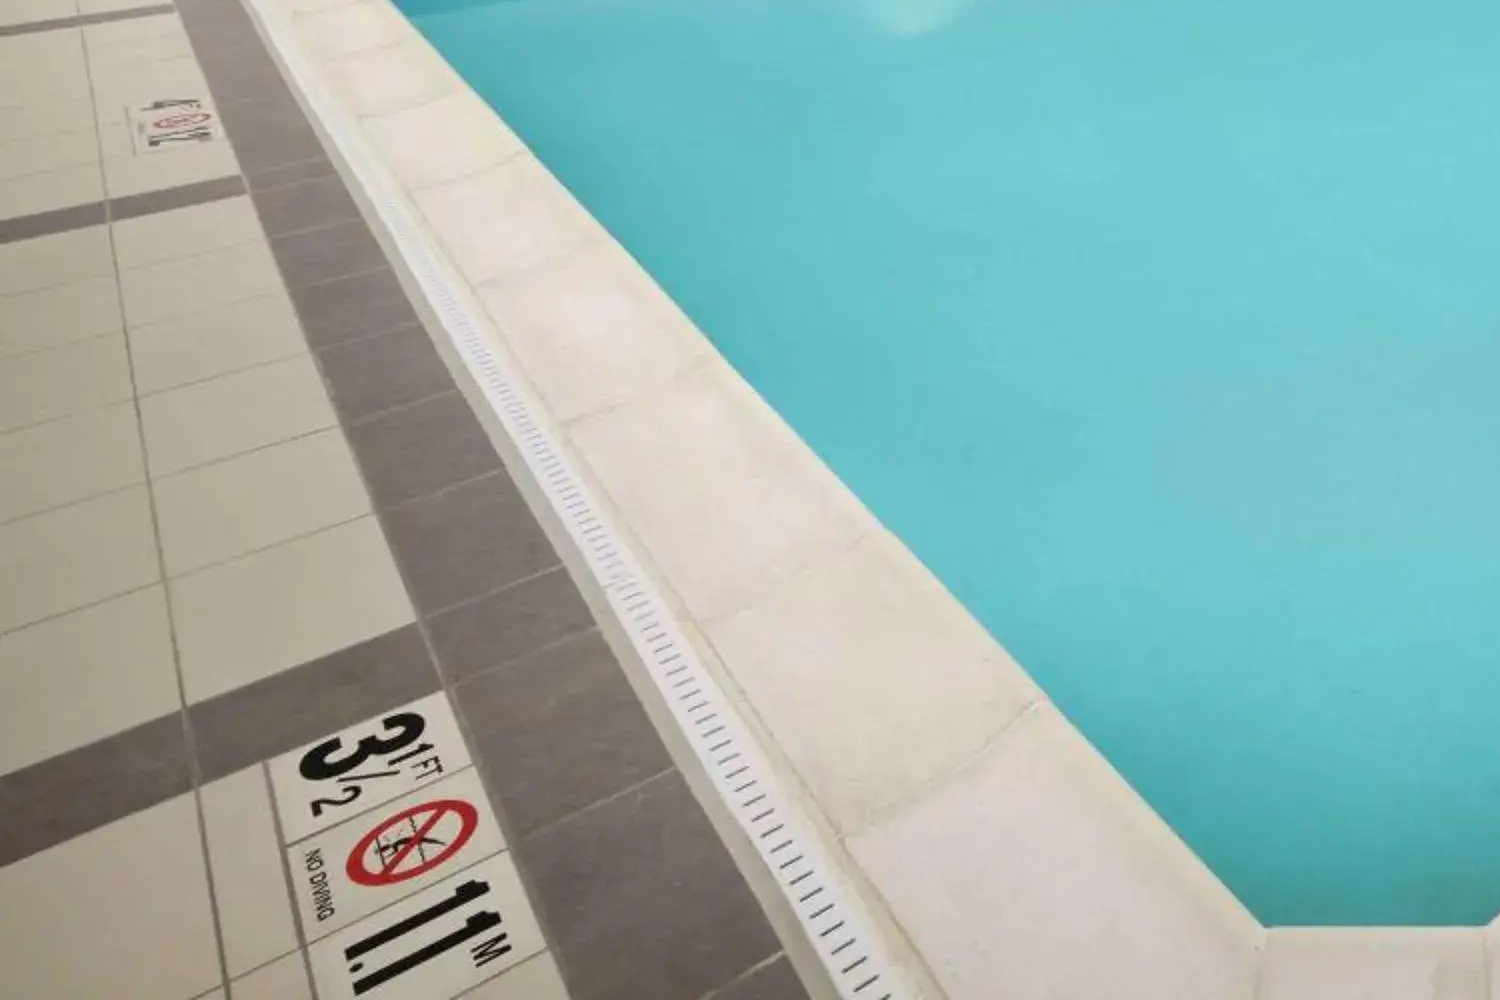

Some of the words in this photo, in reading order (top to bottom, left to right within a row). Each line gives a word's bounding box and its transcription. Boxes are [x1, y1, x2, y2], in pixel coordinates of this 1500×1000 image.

[411, 755, 444, 780] FT
[305, 848, 323, 871] NO
[309, 871, 335, 922] DIVING
[344, 879, 502, 997] 1.1
[470, 932, 512, 968] M
